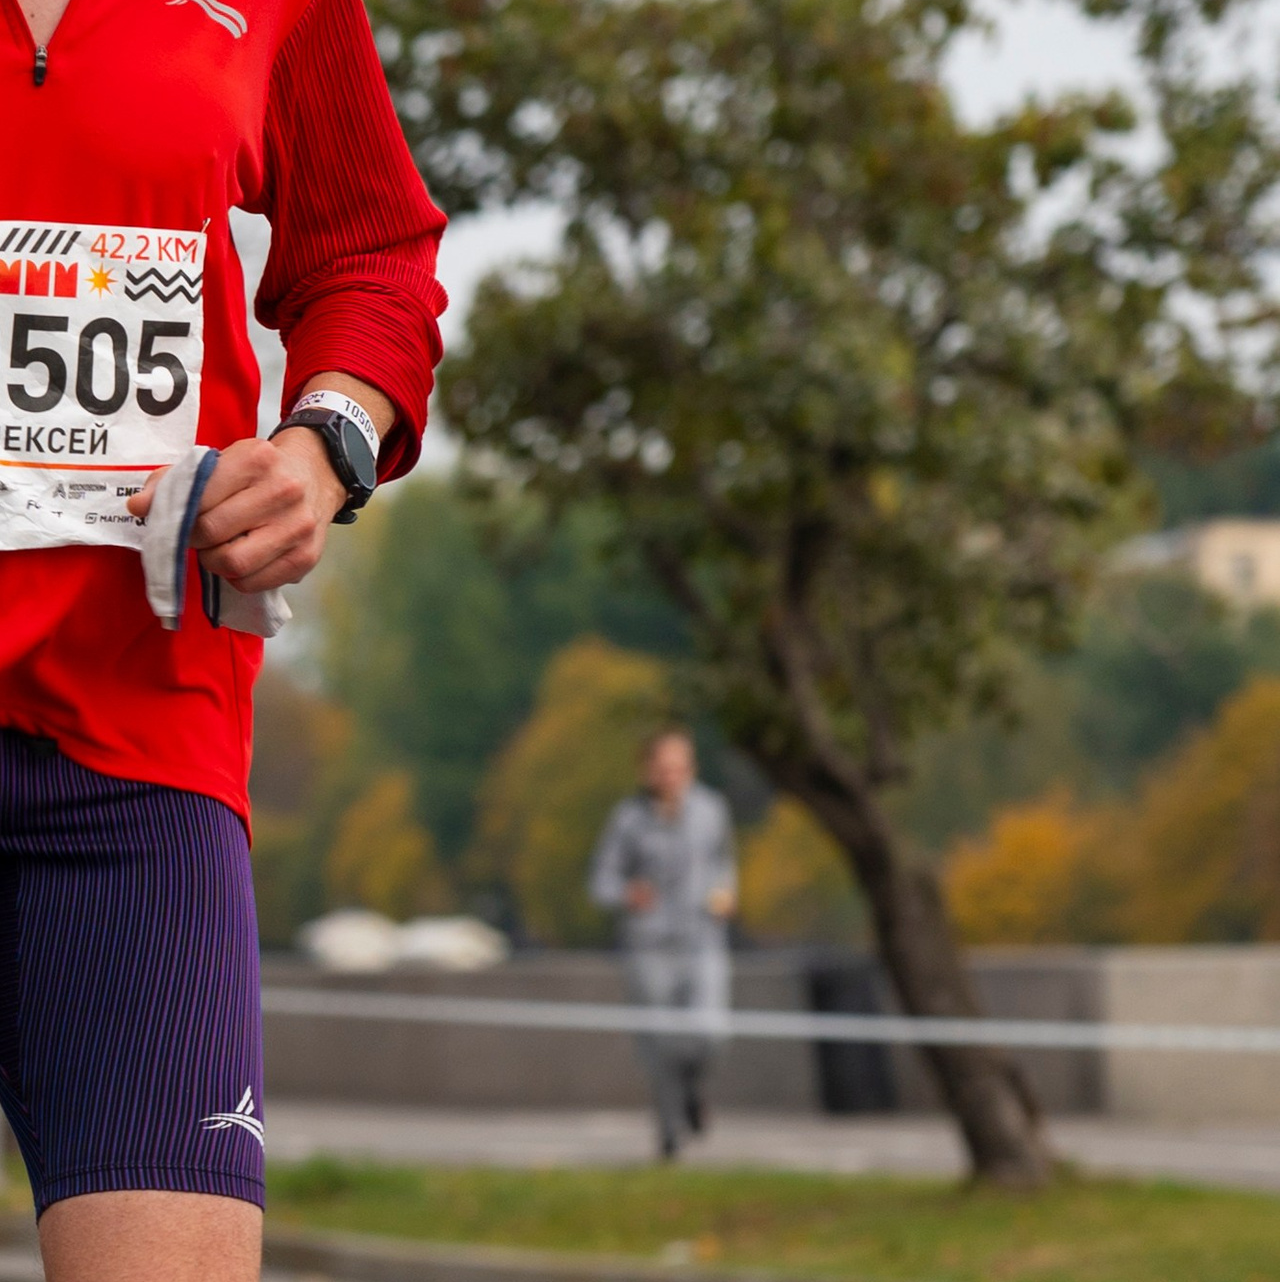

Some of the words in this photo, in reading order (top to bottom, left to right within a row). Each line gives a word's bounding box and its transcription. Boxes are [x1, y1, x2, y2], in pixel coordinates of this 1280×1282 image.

[90, 232, 151, 264] 42,2
[345, 400, 374, 441] 10505
[100, 515, 135, 523] МАГНИТ
